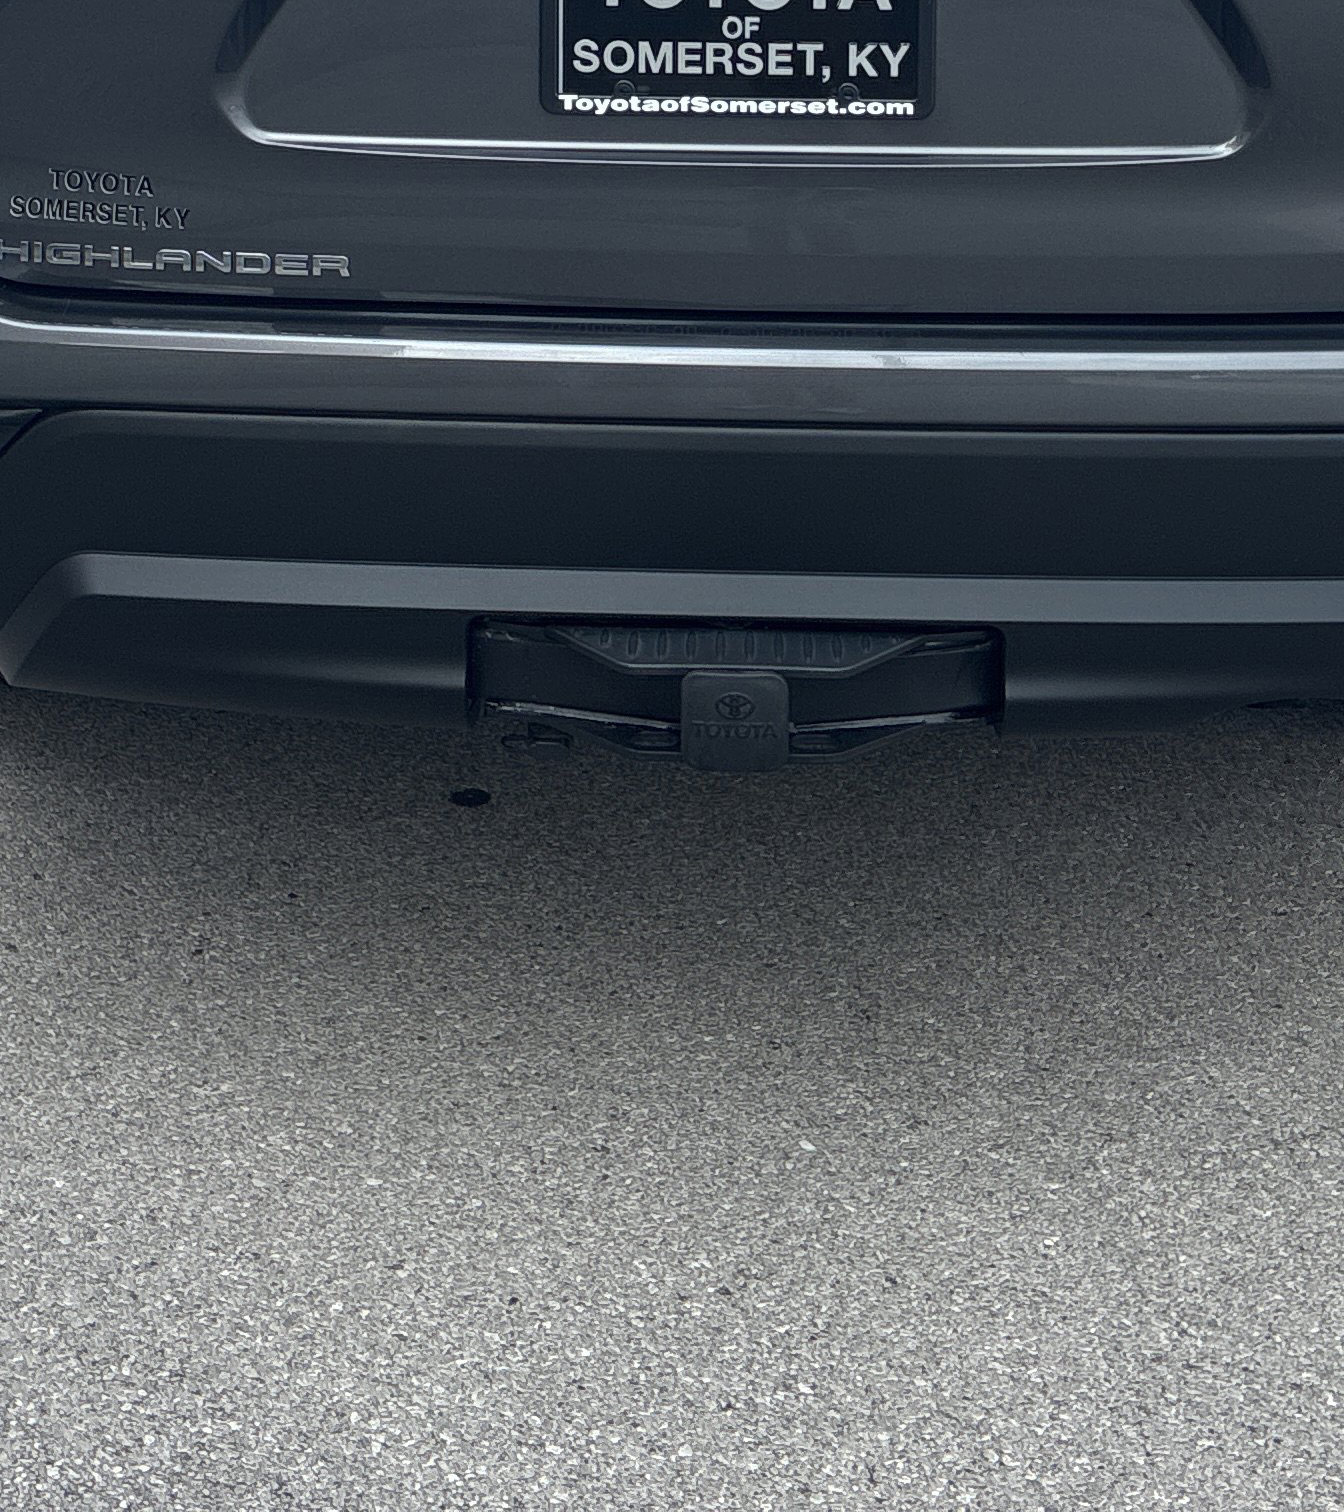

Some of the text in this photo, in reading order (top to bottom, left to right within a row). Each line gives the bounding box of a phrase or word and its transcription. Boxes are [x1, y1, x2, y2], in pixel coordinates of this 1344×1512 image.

[721, 16, 760, 39] OF
[572, 39, 910, 83] SOMERSET, KY
[558, 94, 915, 115] ToyotaofSomerset.com
[48, 167, 154, 198] TOYOTA
[9, 195, 191, 231] SOMERSET, KY
[691, 721, 777, 739] TOYOTA
